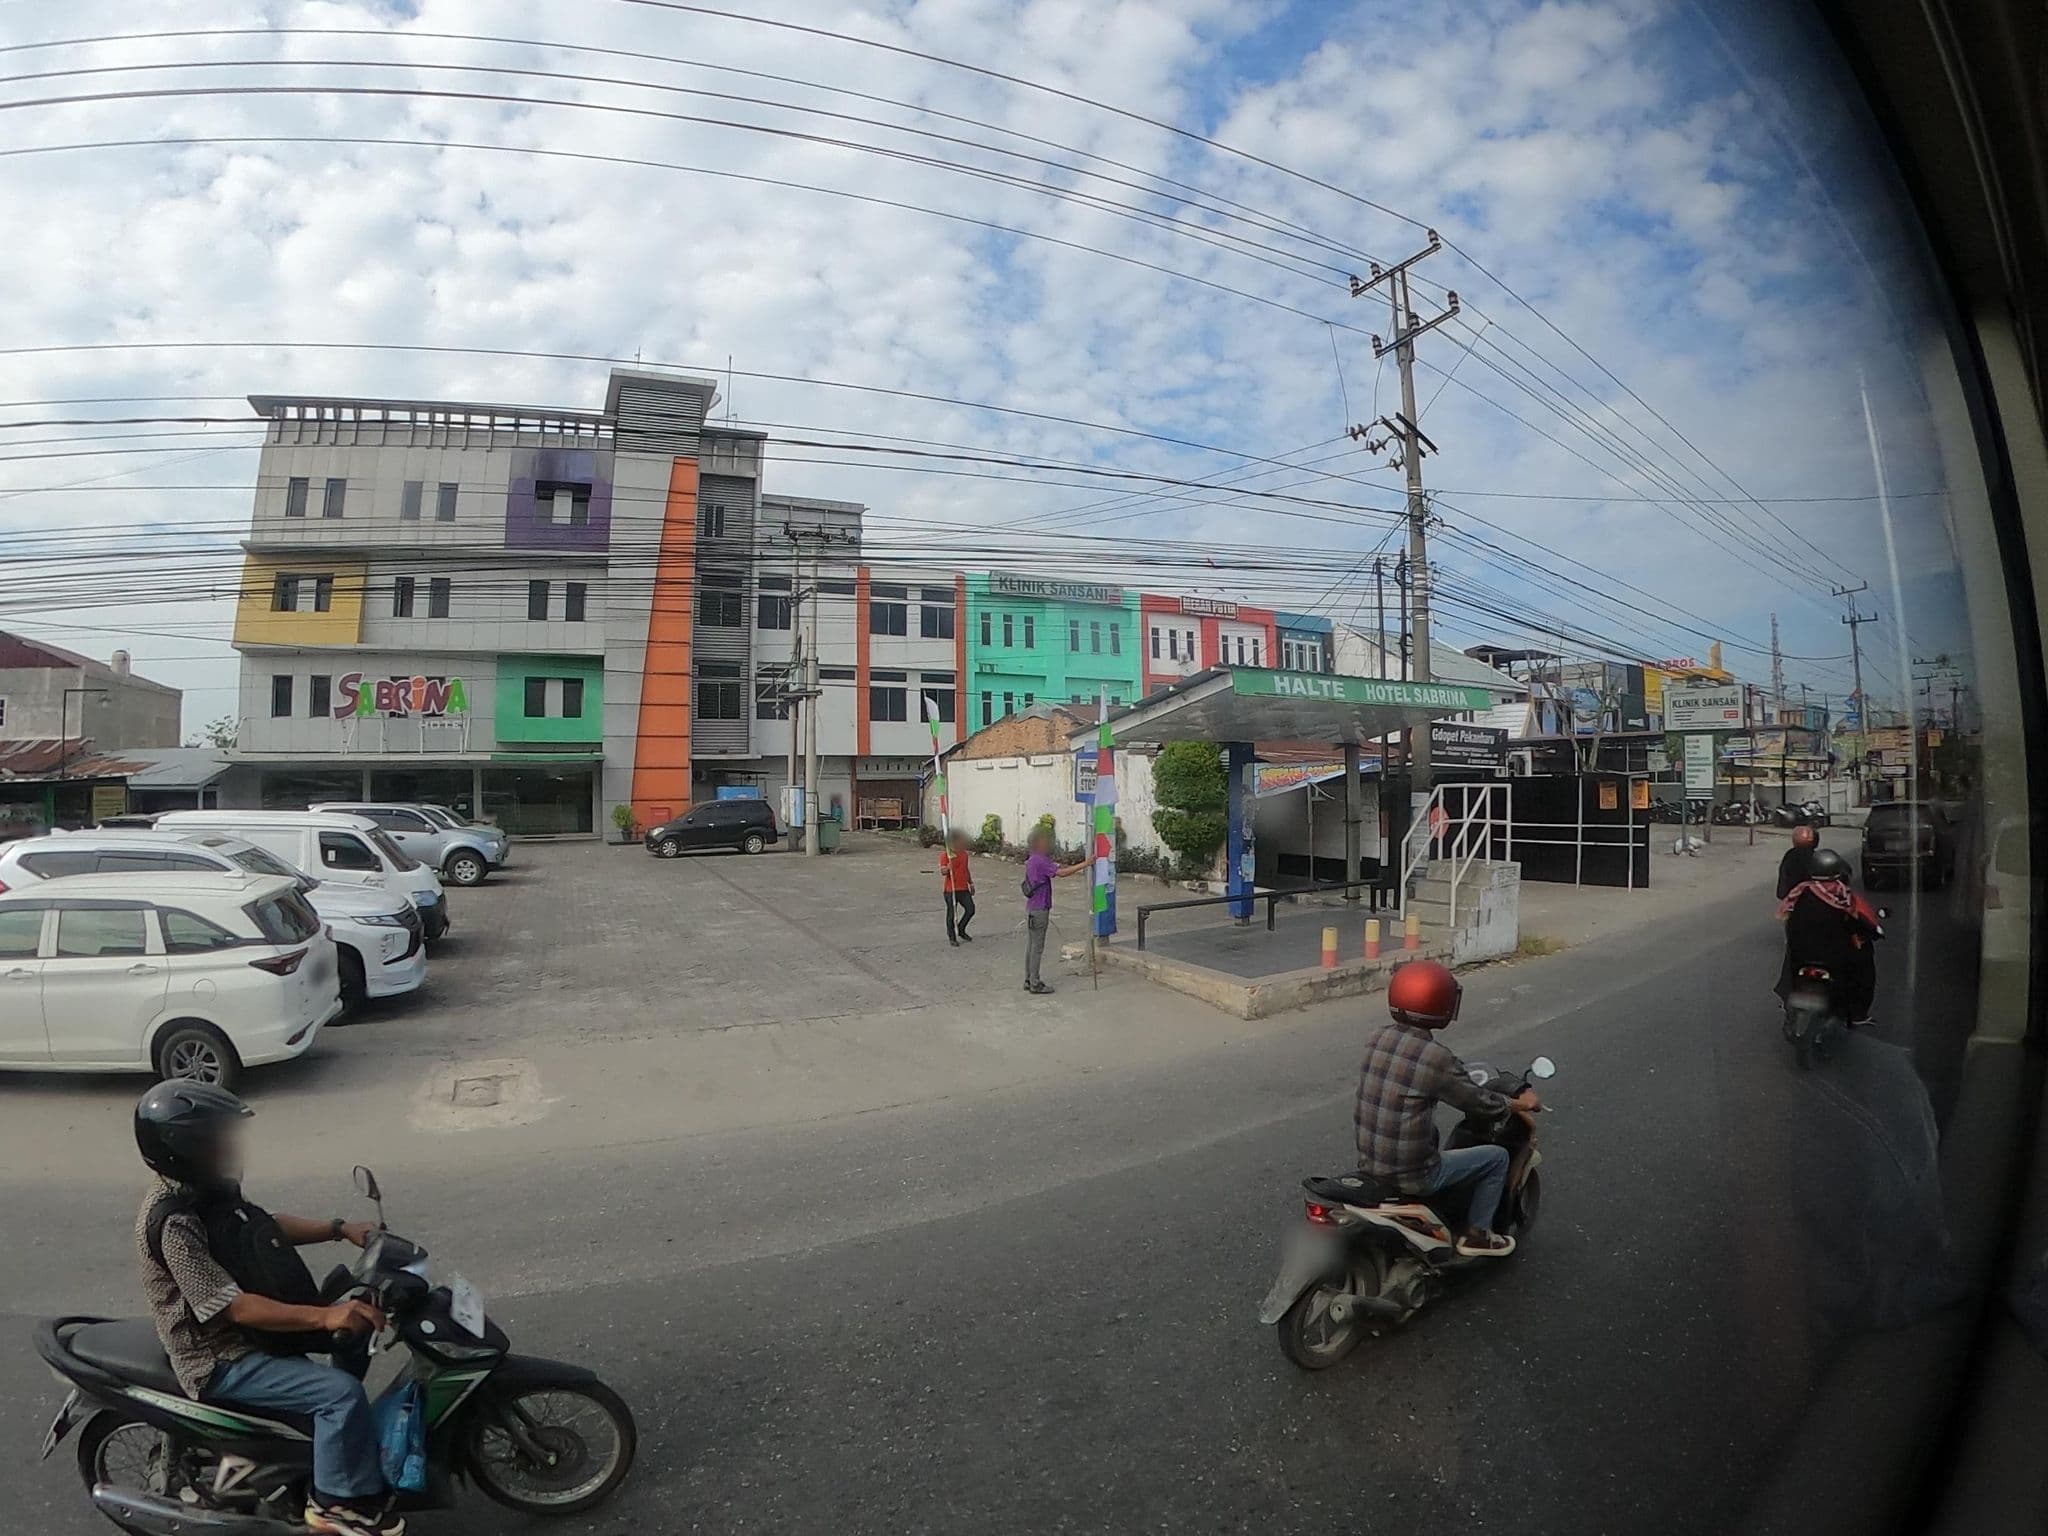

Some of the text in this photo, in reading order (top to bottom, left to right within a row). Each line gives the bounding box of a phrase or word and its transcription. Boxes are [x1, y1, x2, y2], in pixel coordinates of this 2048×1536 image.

[999, 576, 1046, 595] KLINIK
[1050, 582, 1109, 602] SANSANI
[1274, 676, 1345, 698] HALTE
[1365, 683, 1467, 706] HOTEL SABRINA
[1672, 698, 1700, 709] KLINIK
[1702, 696, 1739, 707] SANSANI
